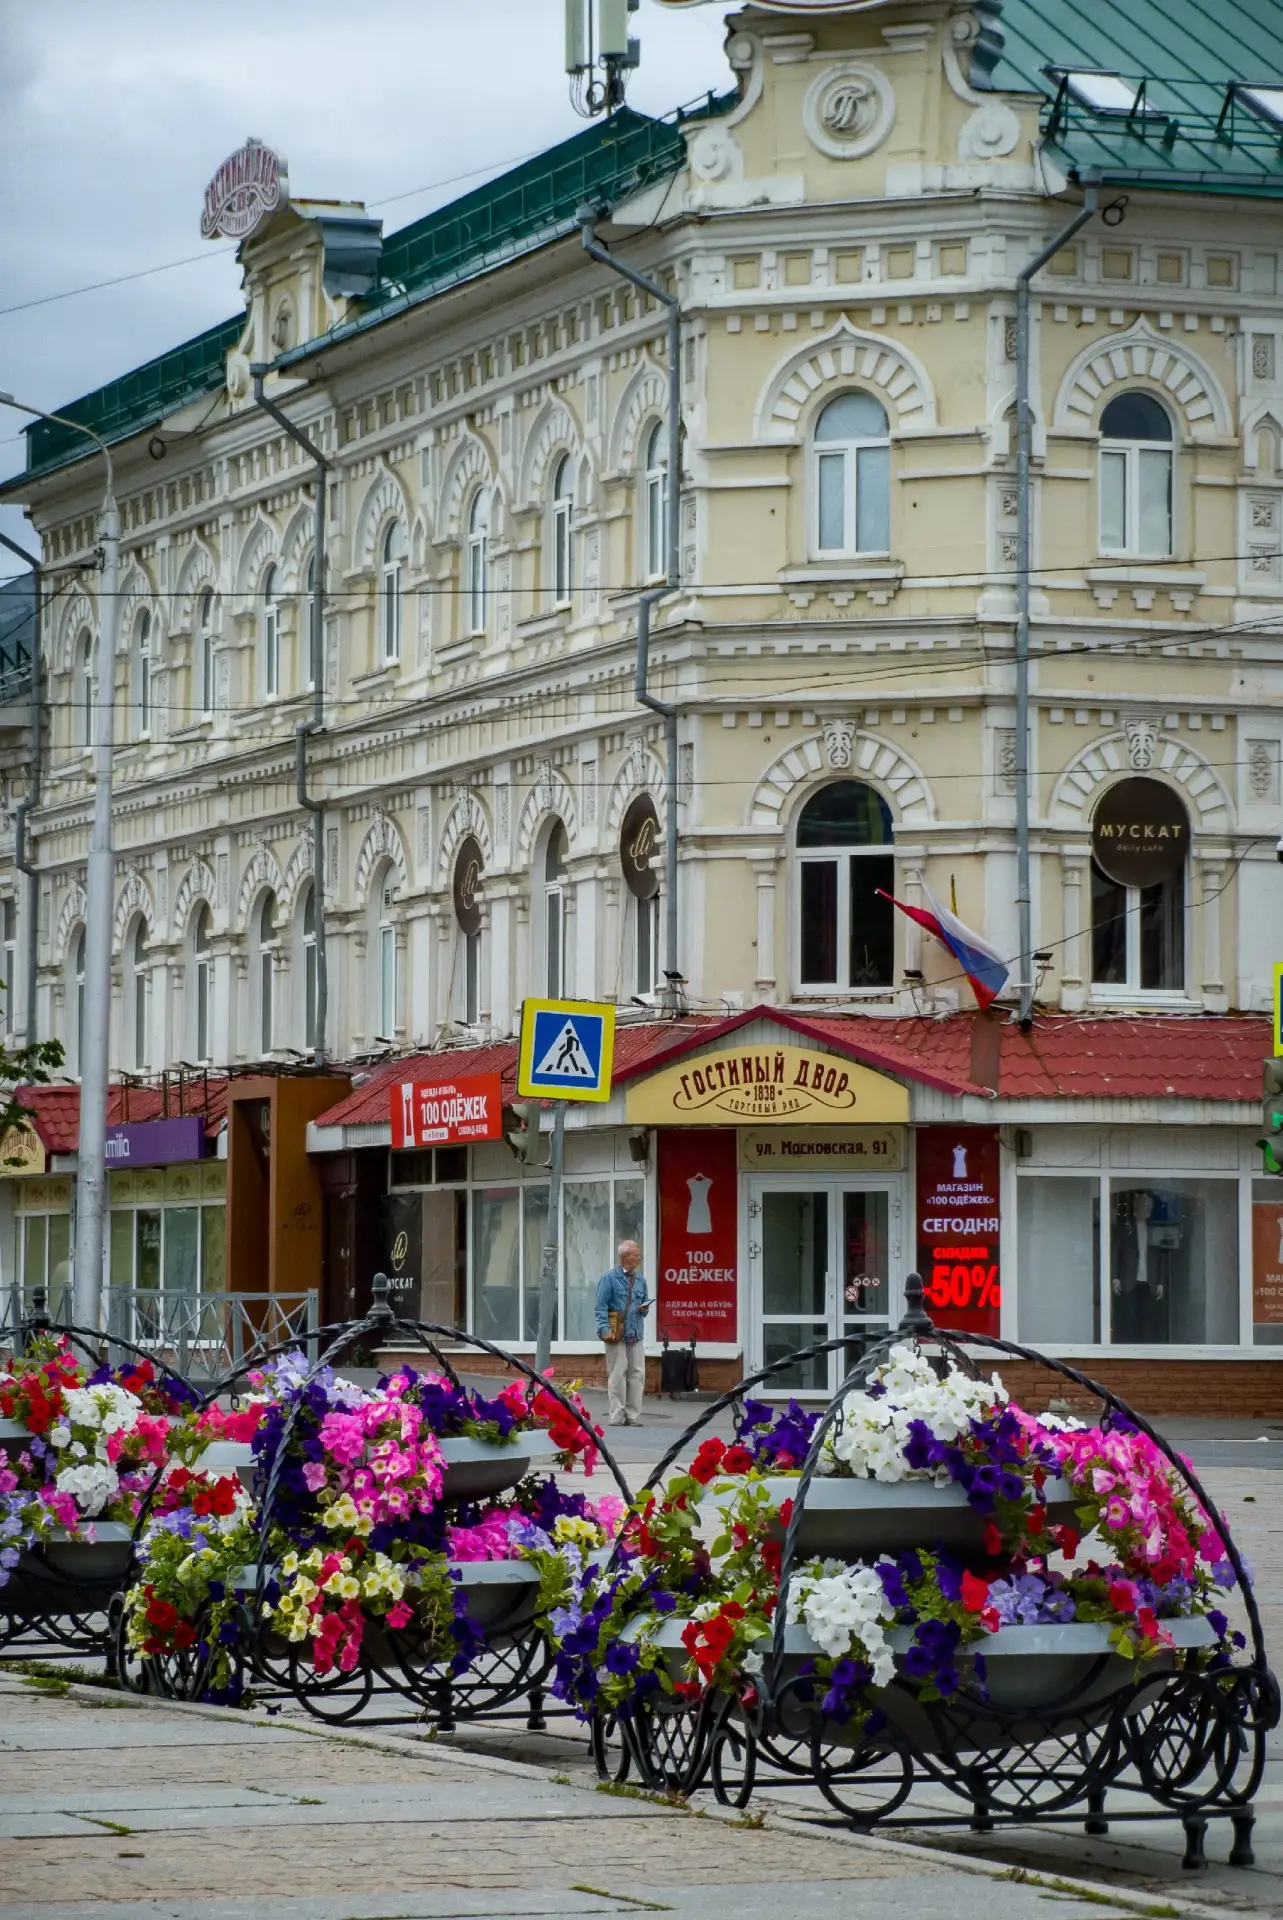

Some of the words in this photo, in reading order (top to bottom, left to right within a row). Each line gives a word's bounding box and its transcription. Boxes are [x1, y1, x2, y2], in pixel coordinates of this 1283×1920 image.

[1100, 824, 1181, 838] МУСКАТ
[680, 1051, 785, 1101] ГОСТИНЫЙ
[793, 1059, 849, 1098] ДВОР
[753, 1085, 776, 1101] 1838
[421, 1101, 440, 1125] 100
[441, 1093, 488, 1128] ОДЁЖЕК
[729, 1099, 777, 1113] ТОРГОВЫЙ
[782, 1098, 800, 1111] РЯД
[756, 1143, 776, 1156] ул.
[781, 1140, 868, 1155] Московская,
[873, 1141, 888, 1154] 91
[936, 1184, 984, 1192] МАГАЗИН
[927, 1196, 948, 1205] «100
[949, 1194, 995, 1206] ОДЁЖЕК»
[922, 1218, 999, 1235] СЕГОДНЯ
[685, 1250, 714, 1264] 100
[664, 1265, 735, 1285] ОДЁЖЕК
[922, 1265, 1002, 1308] -50%
[665, 1301, 698, 1309] ОДЕЖДА
[672, 1310, 727, 1318] СЕКОНД-ХЕНД
